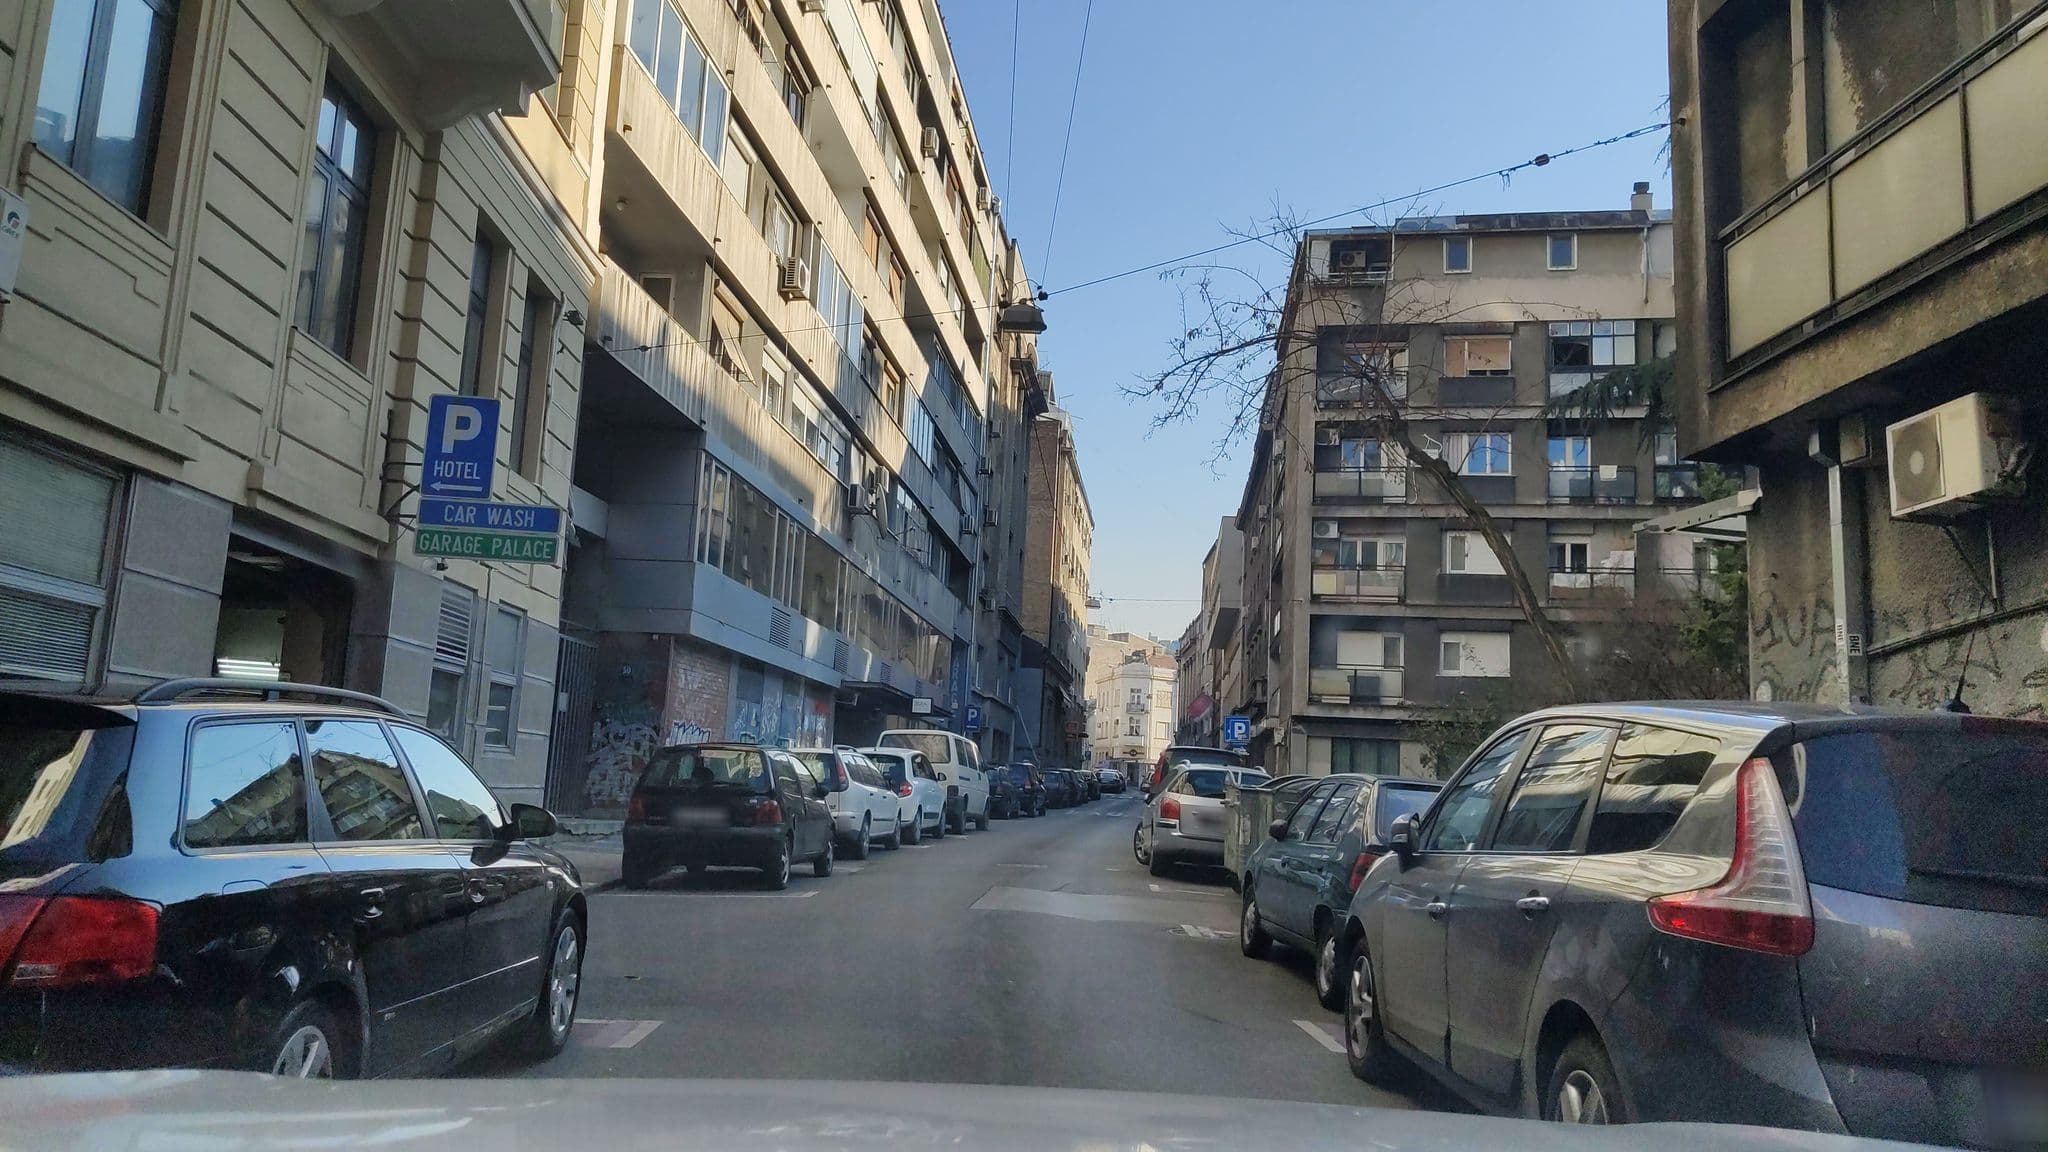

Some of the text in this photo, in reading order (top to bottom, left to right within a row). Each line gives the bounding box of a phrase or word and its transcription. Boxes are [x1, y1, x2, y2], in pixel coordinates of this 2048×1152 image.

[442, 404, 482, 453] P
[433, 460, 481, 480] HOTEL
[444, 504, 536, 528] CAR WASH
[419, 532, 553, 559] GARAGE PALACE
[1849, 635, 1861, 655] BNE
[967, 708, 978, 722] P
[1234, 722, 1246, 739] P
